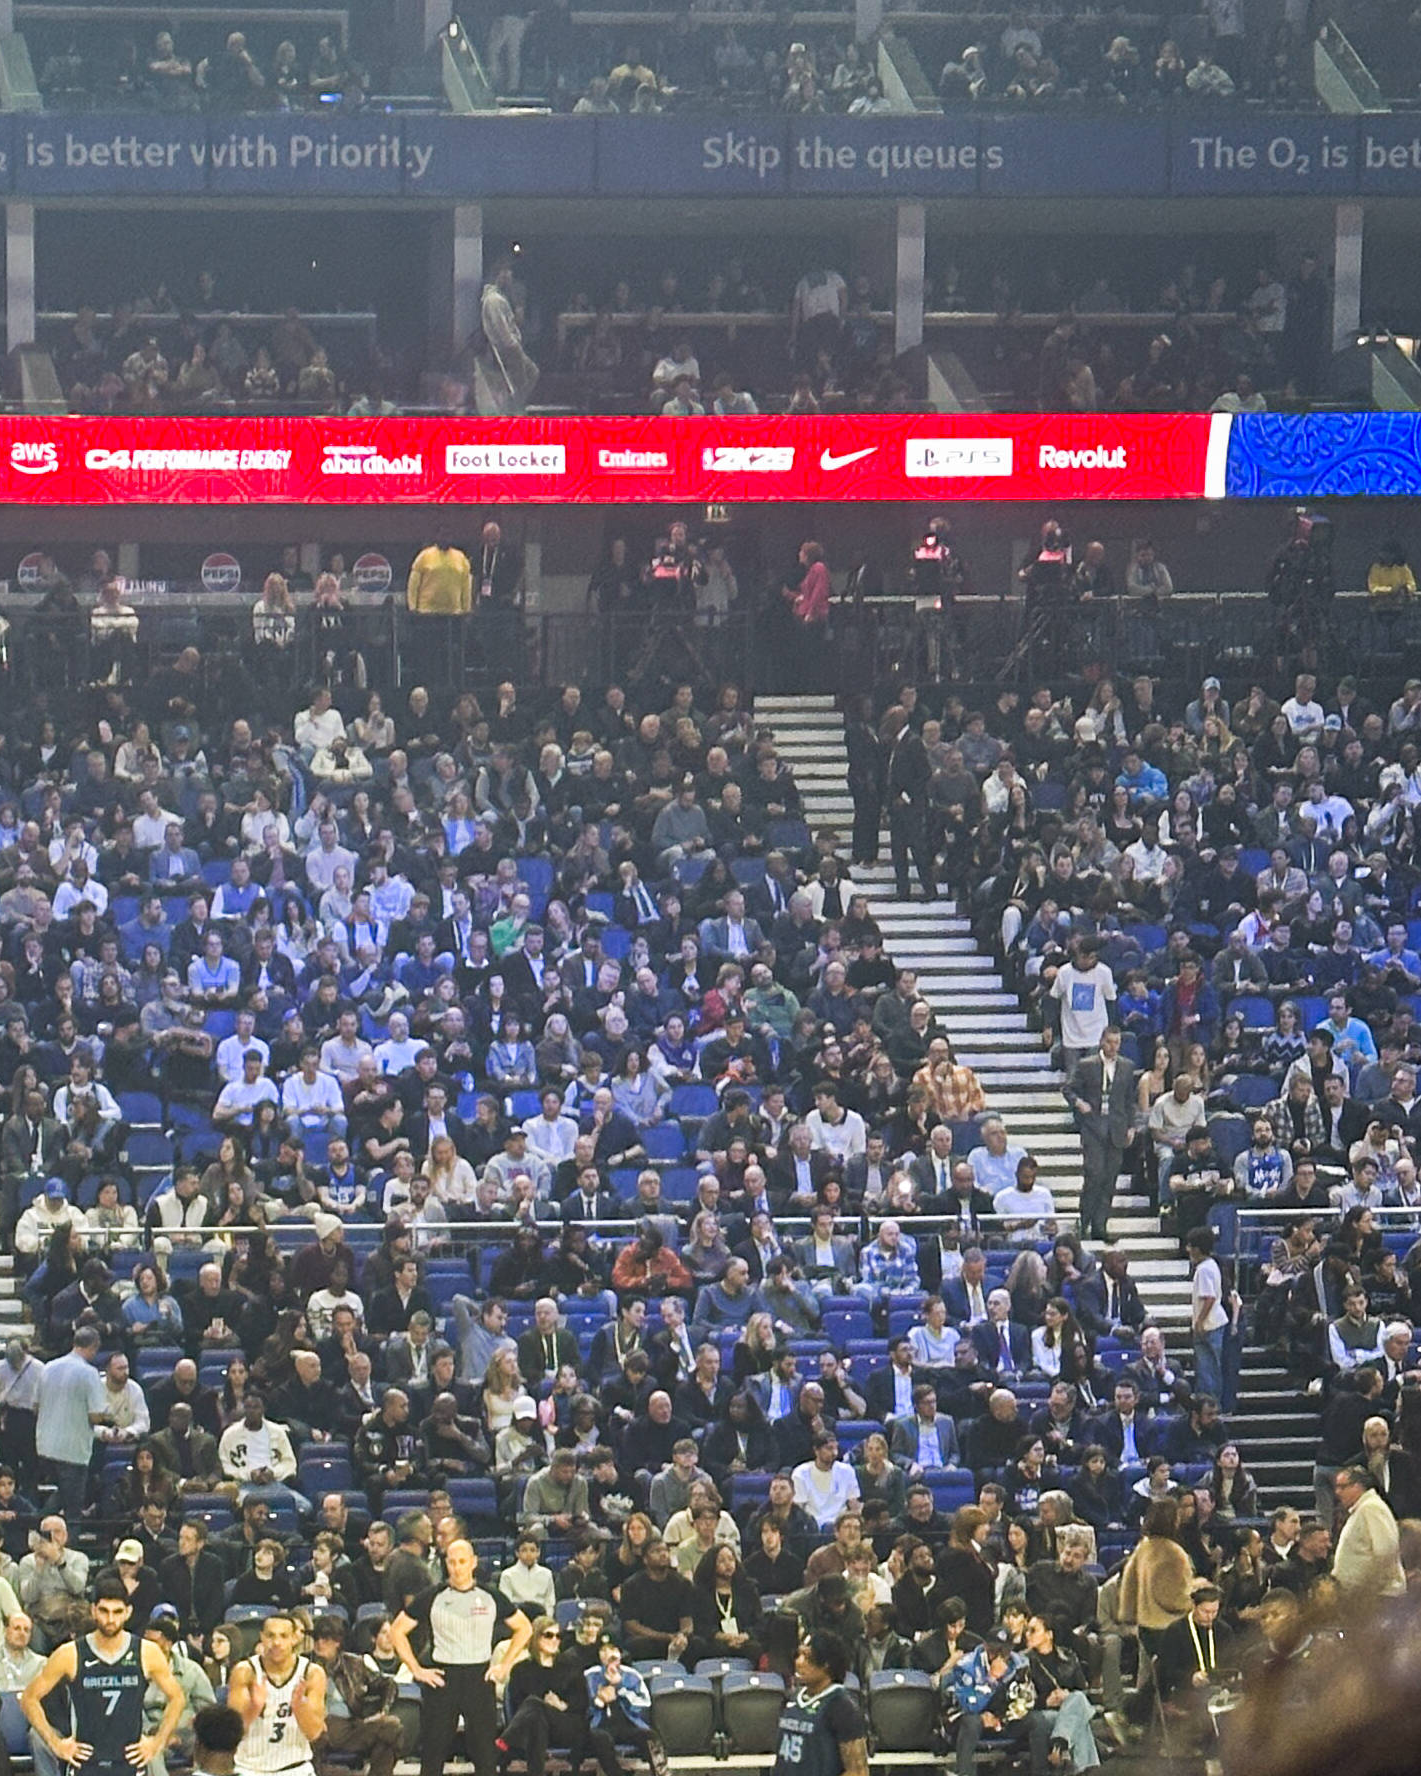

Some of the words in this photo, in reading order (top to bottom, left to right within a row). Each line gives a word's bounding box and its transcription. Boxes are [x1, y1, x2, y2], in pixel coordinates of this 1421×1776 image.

[26, 134, 55, 167] is
[66, 133, 180, 167] better
[189, 133, 277, 168] with
[290, 134, 434, 178] Priority
[702, 132, 779, 178] Skip
[796, 136, 856, 169] the
[866, 144, 1004, 178] queues
[1190, 137, 1257, 170] The
[1322, 136, 1349, 169] is
[11, 441, 57, 461] aws
[132, 449, 240, 470] PERFORMANCE
[240, 449, 293, 470] ENERGY
[452, 451, 490, 467] Foot
[498, 451, 559, 468] Locker
[598, 449, 668, 467] Emirates
[946, 450, 1001, 465] PS5
[1038, 444, 1128, 470] Revolut
[320, 453, 361, 474] abu
[363, 453, 423, 475] dhabi
[203, 567, 239, 580] PEPSI
[355, 567, 391, 580] PEPSI
[101, 1689, 122, 1716] 7
[268, 1722, 286, 1743] 3
